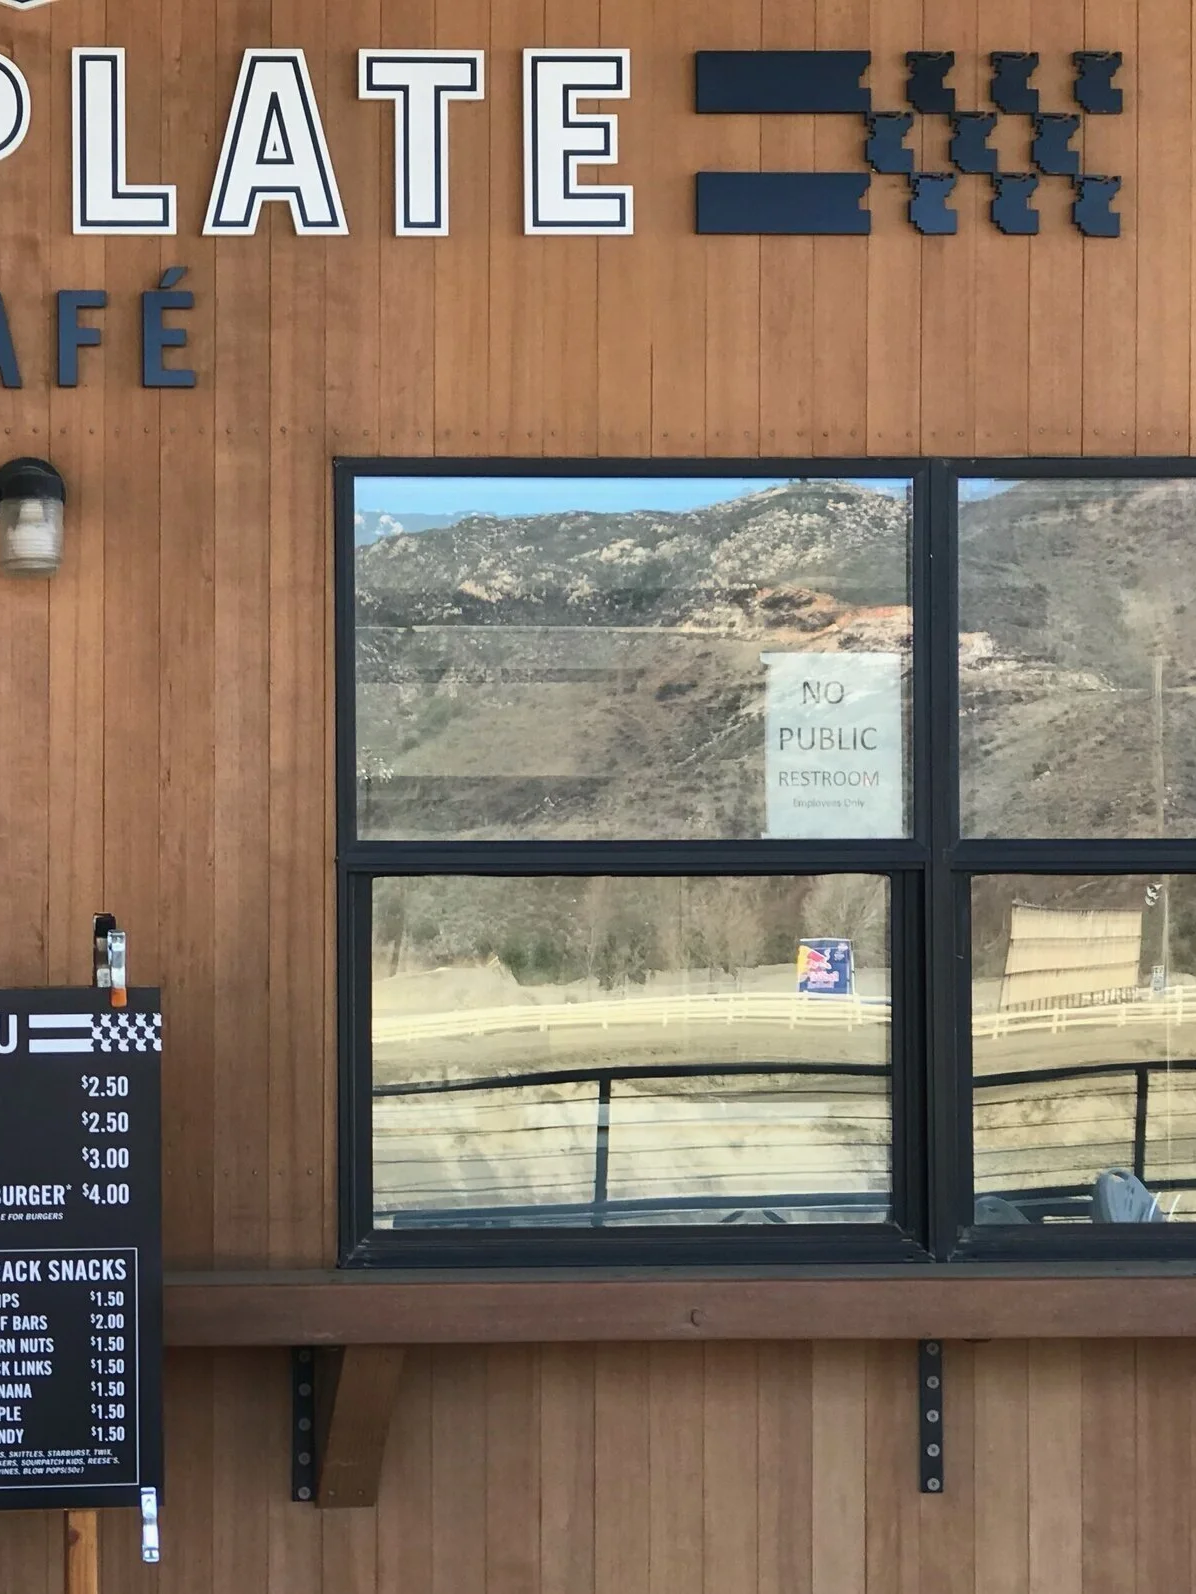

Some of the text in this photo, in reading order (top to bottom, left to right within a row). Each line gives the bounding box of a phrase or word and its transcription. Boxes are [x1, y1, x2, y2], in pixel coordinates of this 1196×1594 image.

[802, 681, 845, 704] NO
[779, 727, 877, 750] PUBLIC
[779, 771, 879, 787] RESTROOM
[82, 1075, 128, 1096] $2.50
[82, 1111, 128, 1132] $2.50
[82, 1147, 128, 1168] $3.00
[83, 1183, 129, 1204] $4.00
[8, 1212, 24, 1221] FOR
[26, 1212, 63, 1221] BURGERS
[49, 1259, 126, 1281] SNACKS
[90, 1291, 123, 1306] $1.50
[13, 1315, 47, 1330] BARS
[91, 1314, 124, 1329] $2.00
[20, 1338, 54, 1353] NUTS
[91, 1336, 124, 1351] $1.50
[14, 1361, 52, 1375] LINKS
[91, 1359, 124, 1374] $1.50
[91, 1381, 124, 1396] $1.50
[91, 1404, 124, 1419] $1.50
[91, 1426, 124, 1441] $1.50
[9, 1450, 45, 1459] SKITTLES,
[48, 1448, 90, 1458] STARBURST,
[21, 1458, 64, 1467] SOURPATCH
[23, 1467, 44, 1475] BLOW
